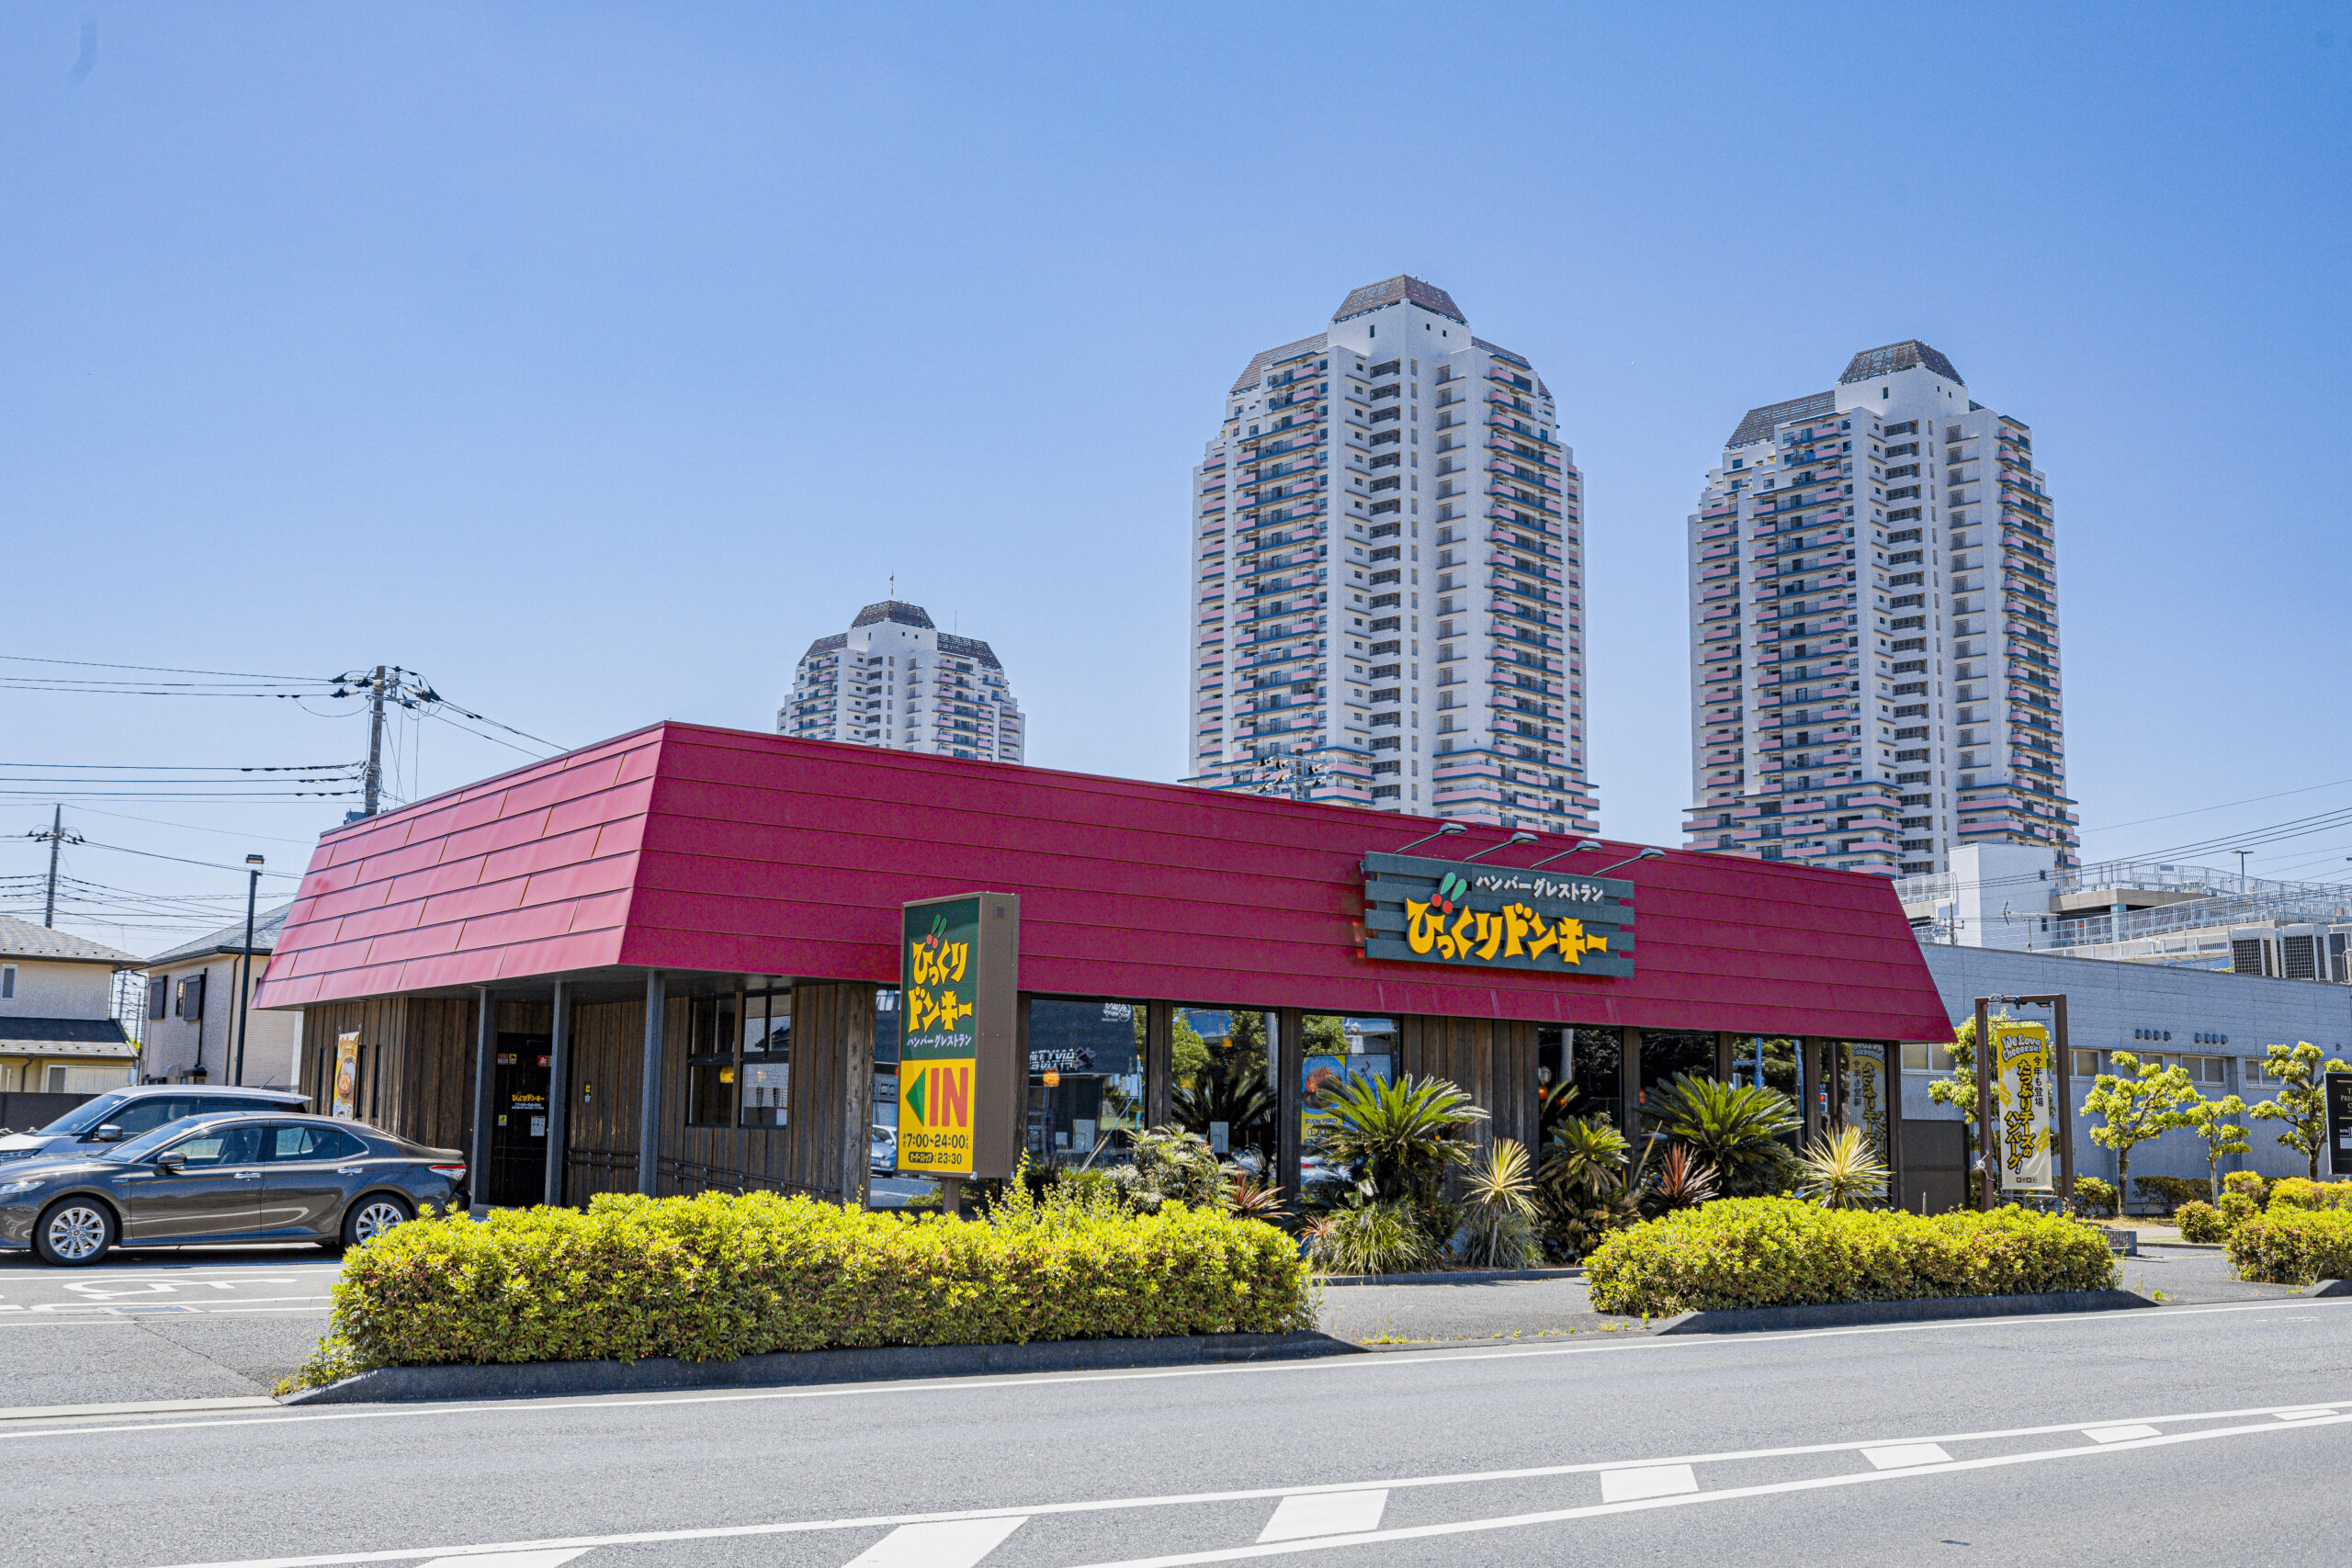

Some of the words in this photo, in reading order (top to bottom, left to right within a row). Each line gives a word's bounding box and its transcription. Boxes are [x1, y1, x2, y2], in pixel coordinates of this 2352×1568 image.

[1475, 874, 1604, 903] ハンバーグレストラン
[1405, 897, 1608, 966] びっくりドンキー
[912, 937, 968, 987] びっくり
[908, 986, 973, 1034] ドンキー
[906, 1033, 972, 1049] ハンバーグレストラン
[2001, 1034, 2018, 1049] We
[2018, 1033, 2042, 1046] Love
[929, 1066, 969, 1128] IN
[2032, 1055, 2044, 1108] 今年も登場
[2017, 1059, 2036, 1158] たっぷりチーズの
[937, 1152, 963, 1165] 23:30
